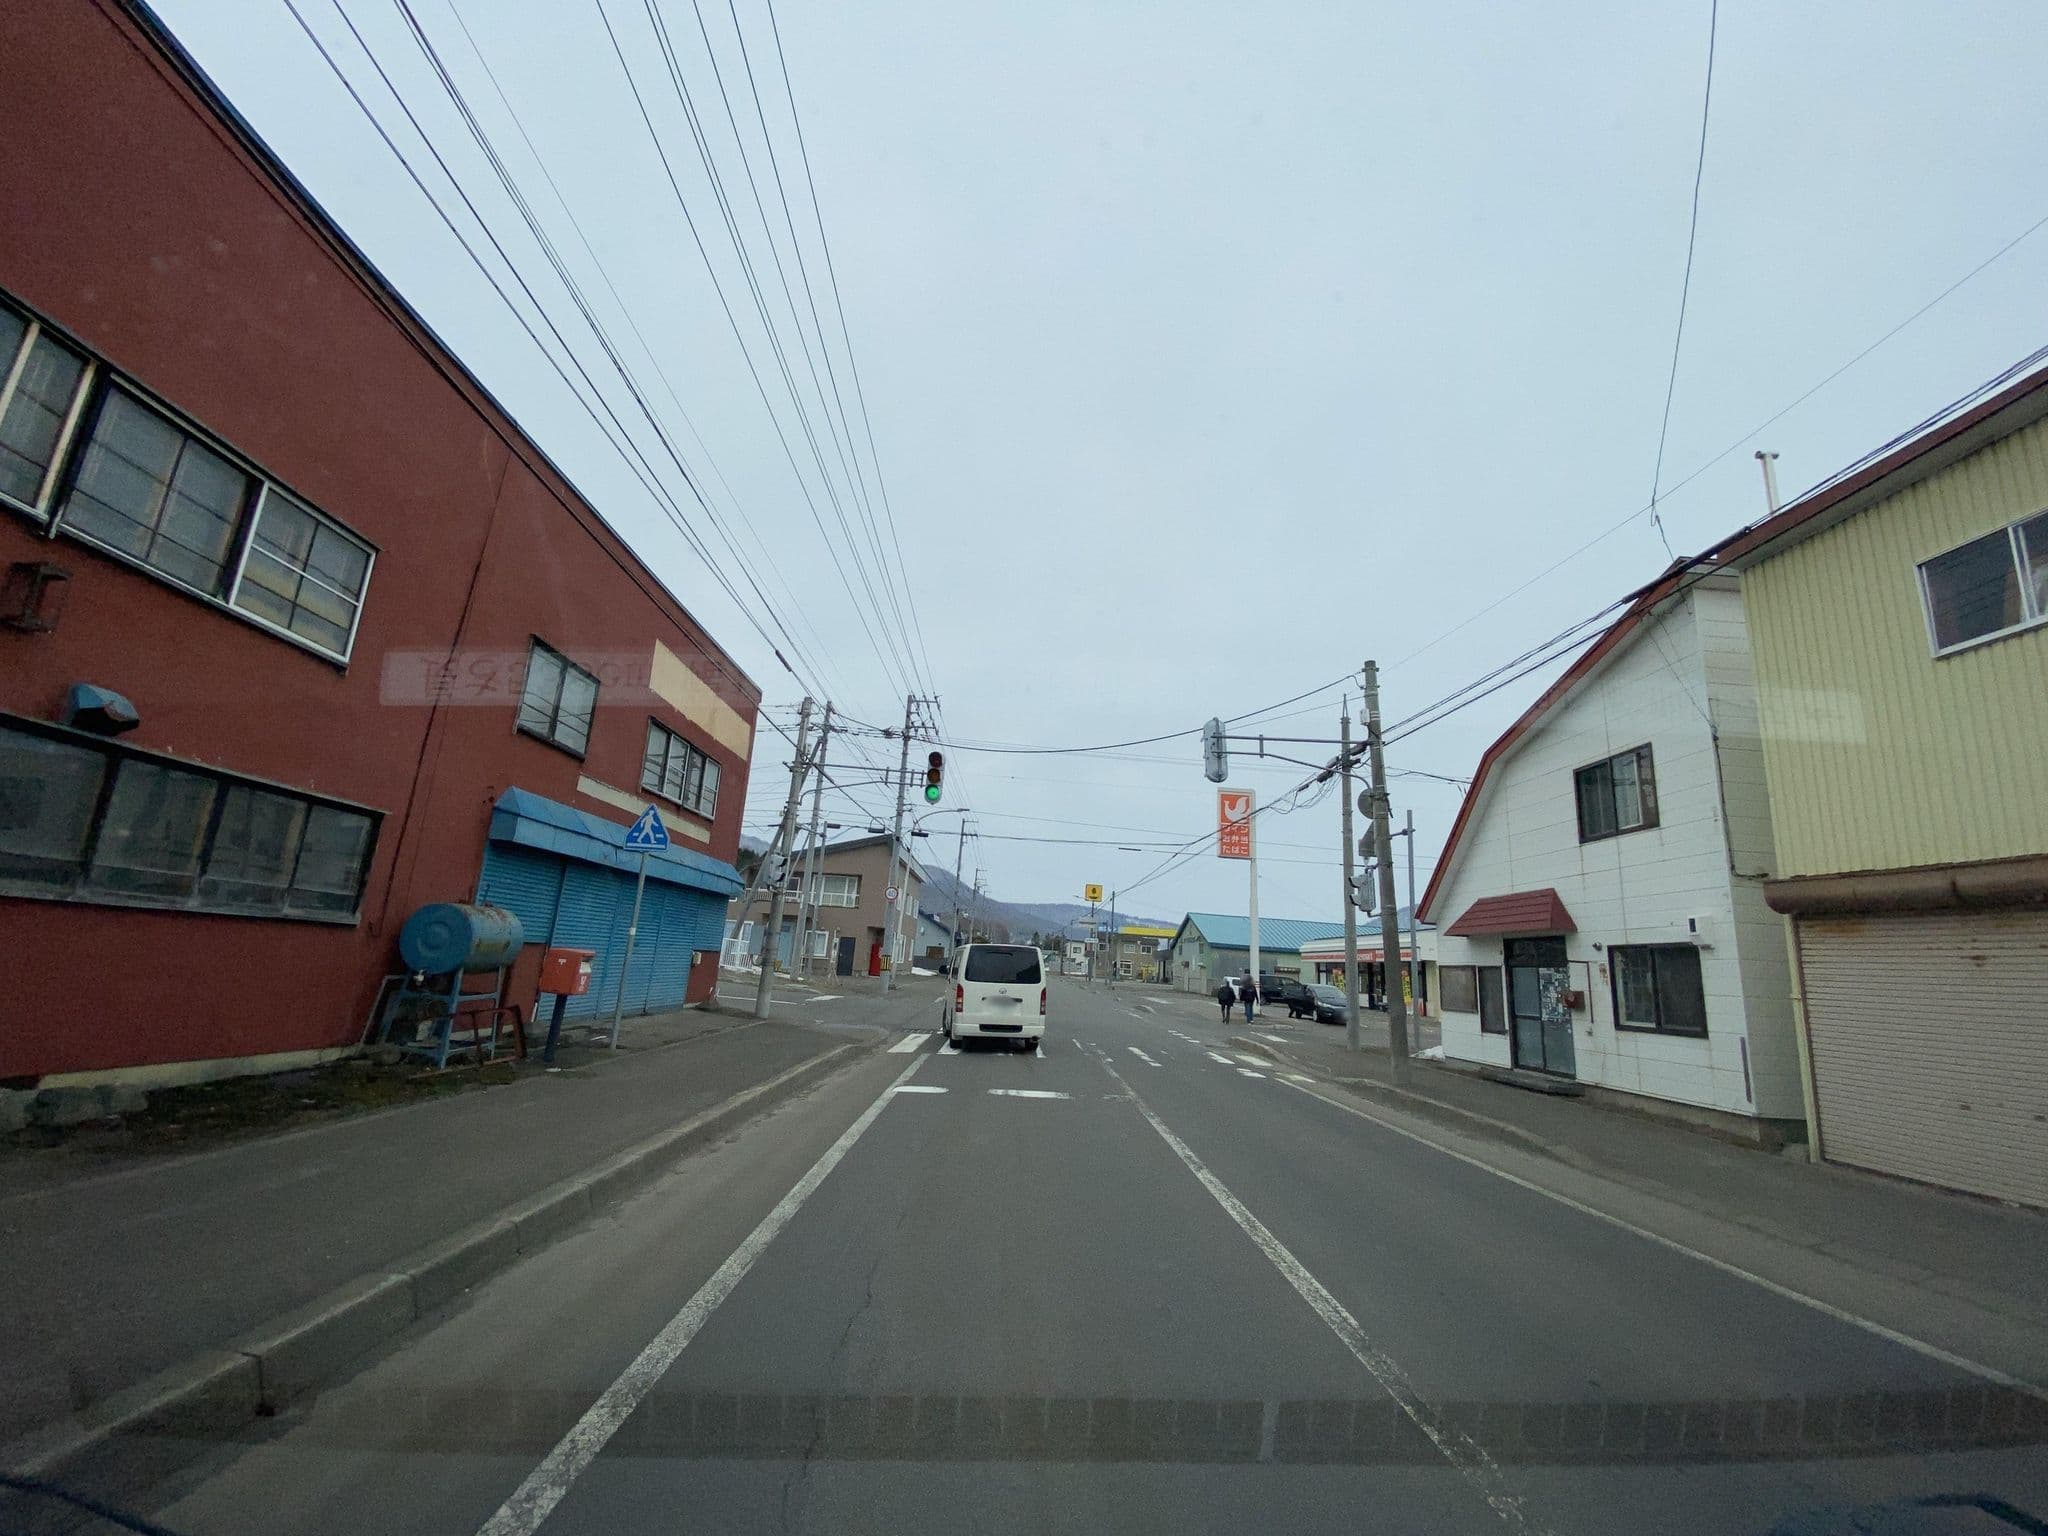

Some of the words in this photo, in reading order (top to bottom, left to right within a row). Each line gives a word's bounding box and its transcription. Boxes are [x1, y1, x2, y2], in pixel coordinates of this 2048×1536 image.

[1222, 835, 1248, 844] お弁当
[1222, 846, 1248, 855] たばこ
